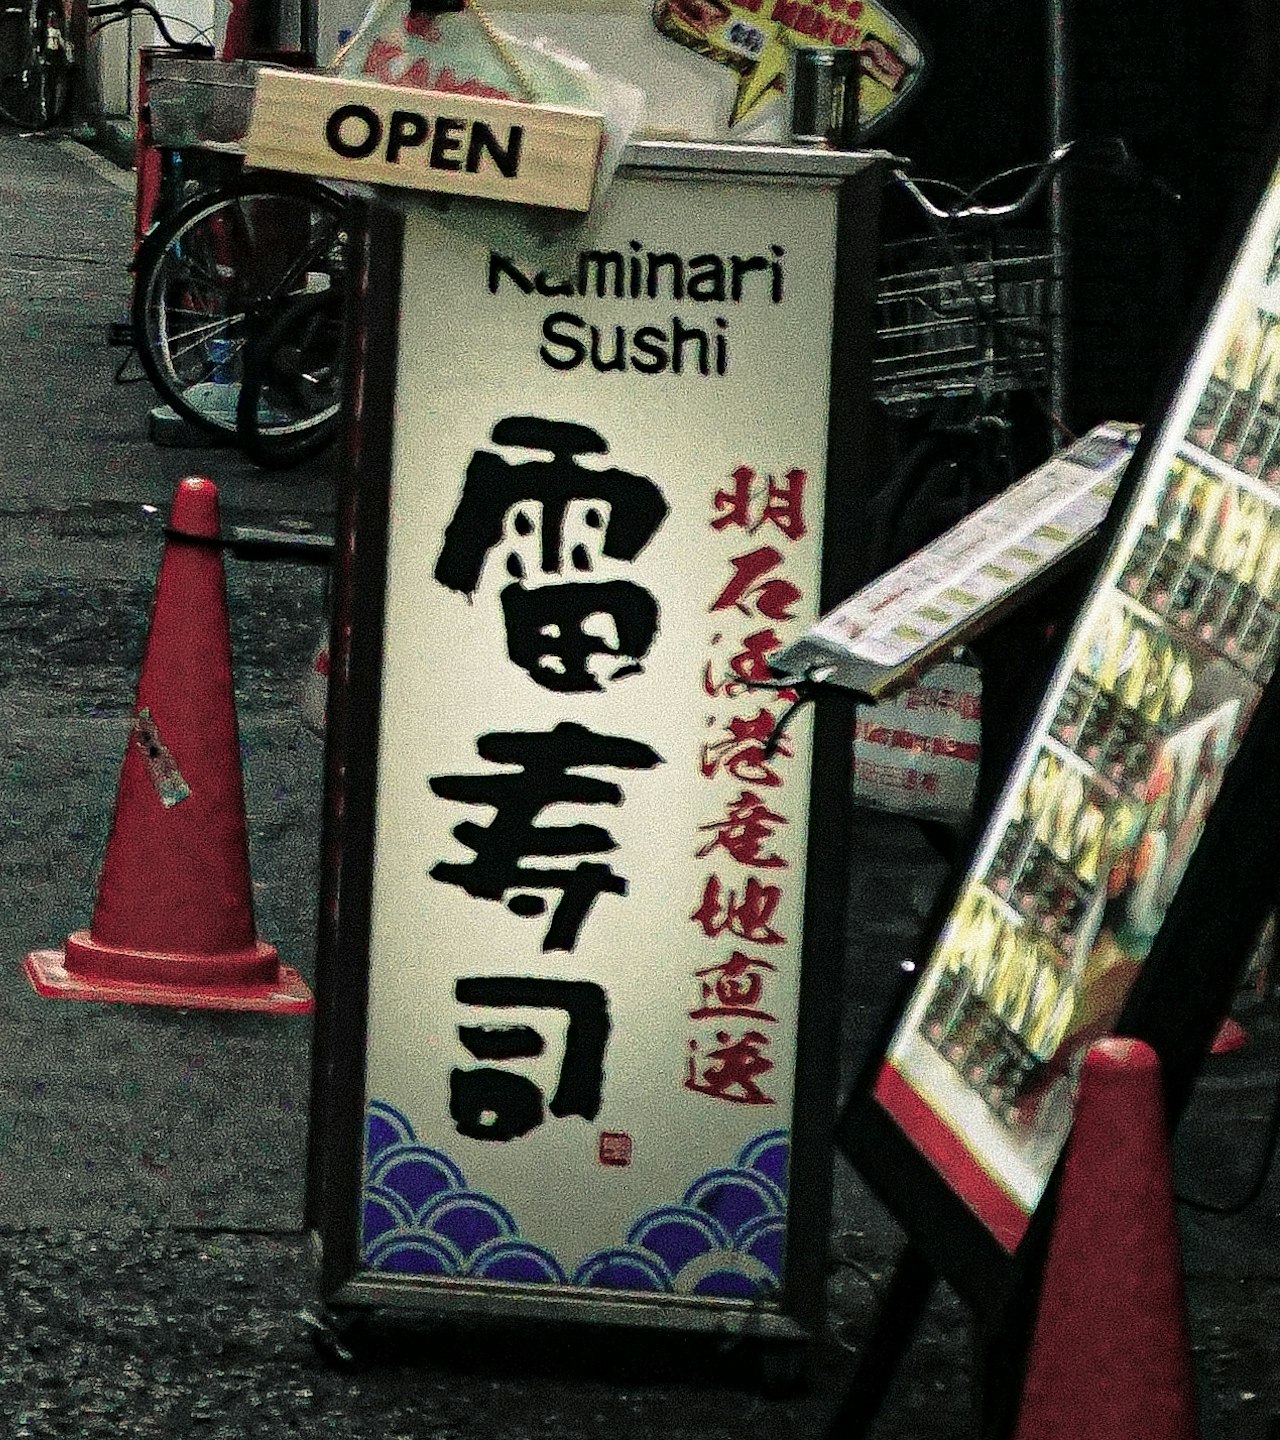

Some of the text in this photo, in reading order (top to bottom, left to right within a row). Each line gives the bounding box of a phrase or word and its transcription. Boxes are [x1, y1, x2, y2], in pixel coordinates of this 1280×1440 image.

[325, 103, 524, 178] OPEN
[540, 311, 729, 376] Sushi
[429, 414, 671, 1142] 雷寿司
